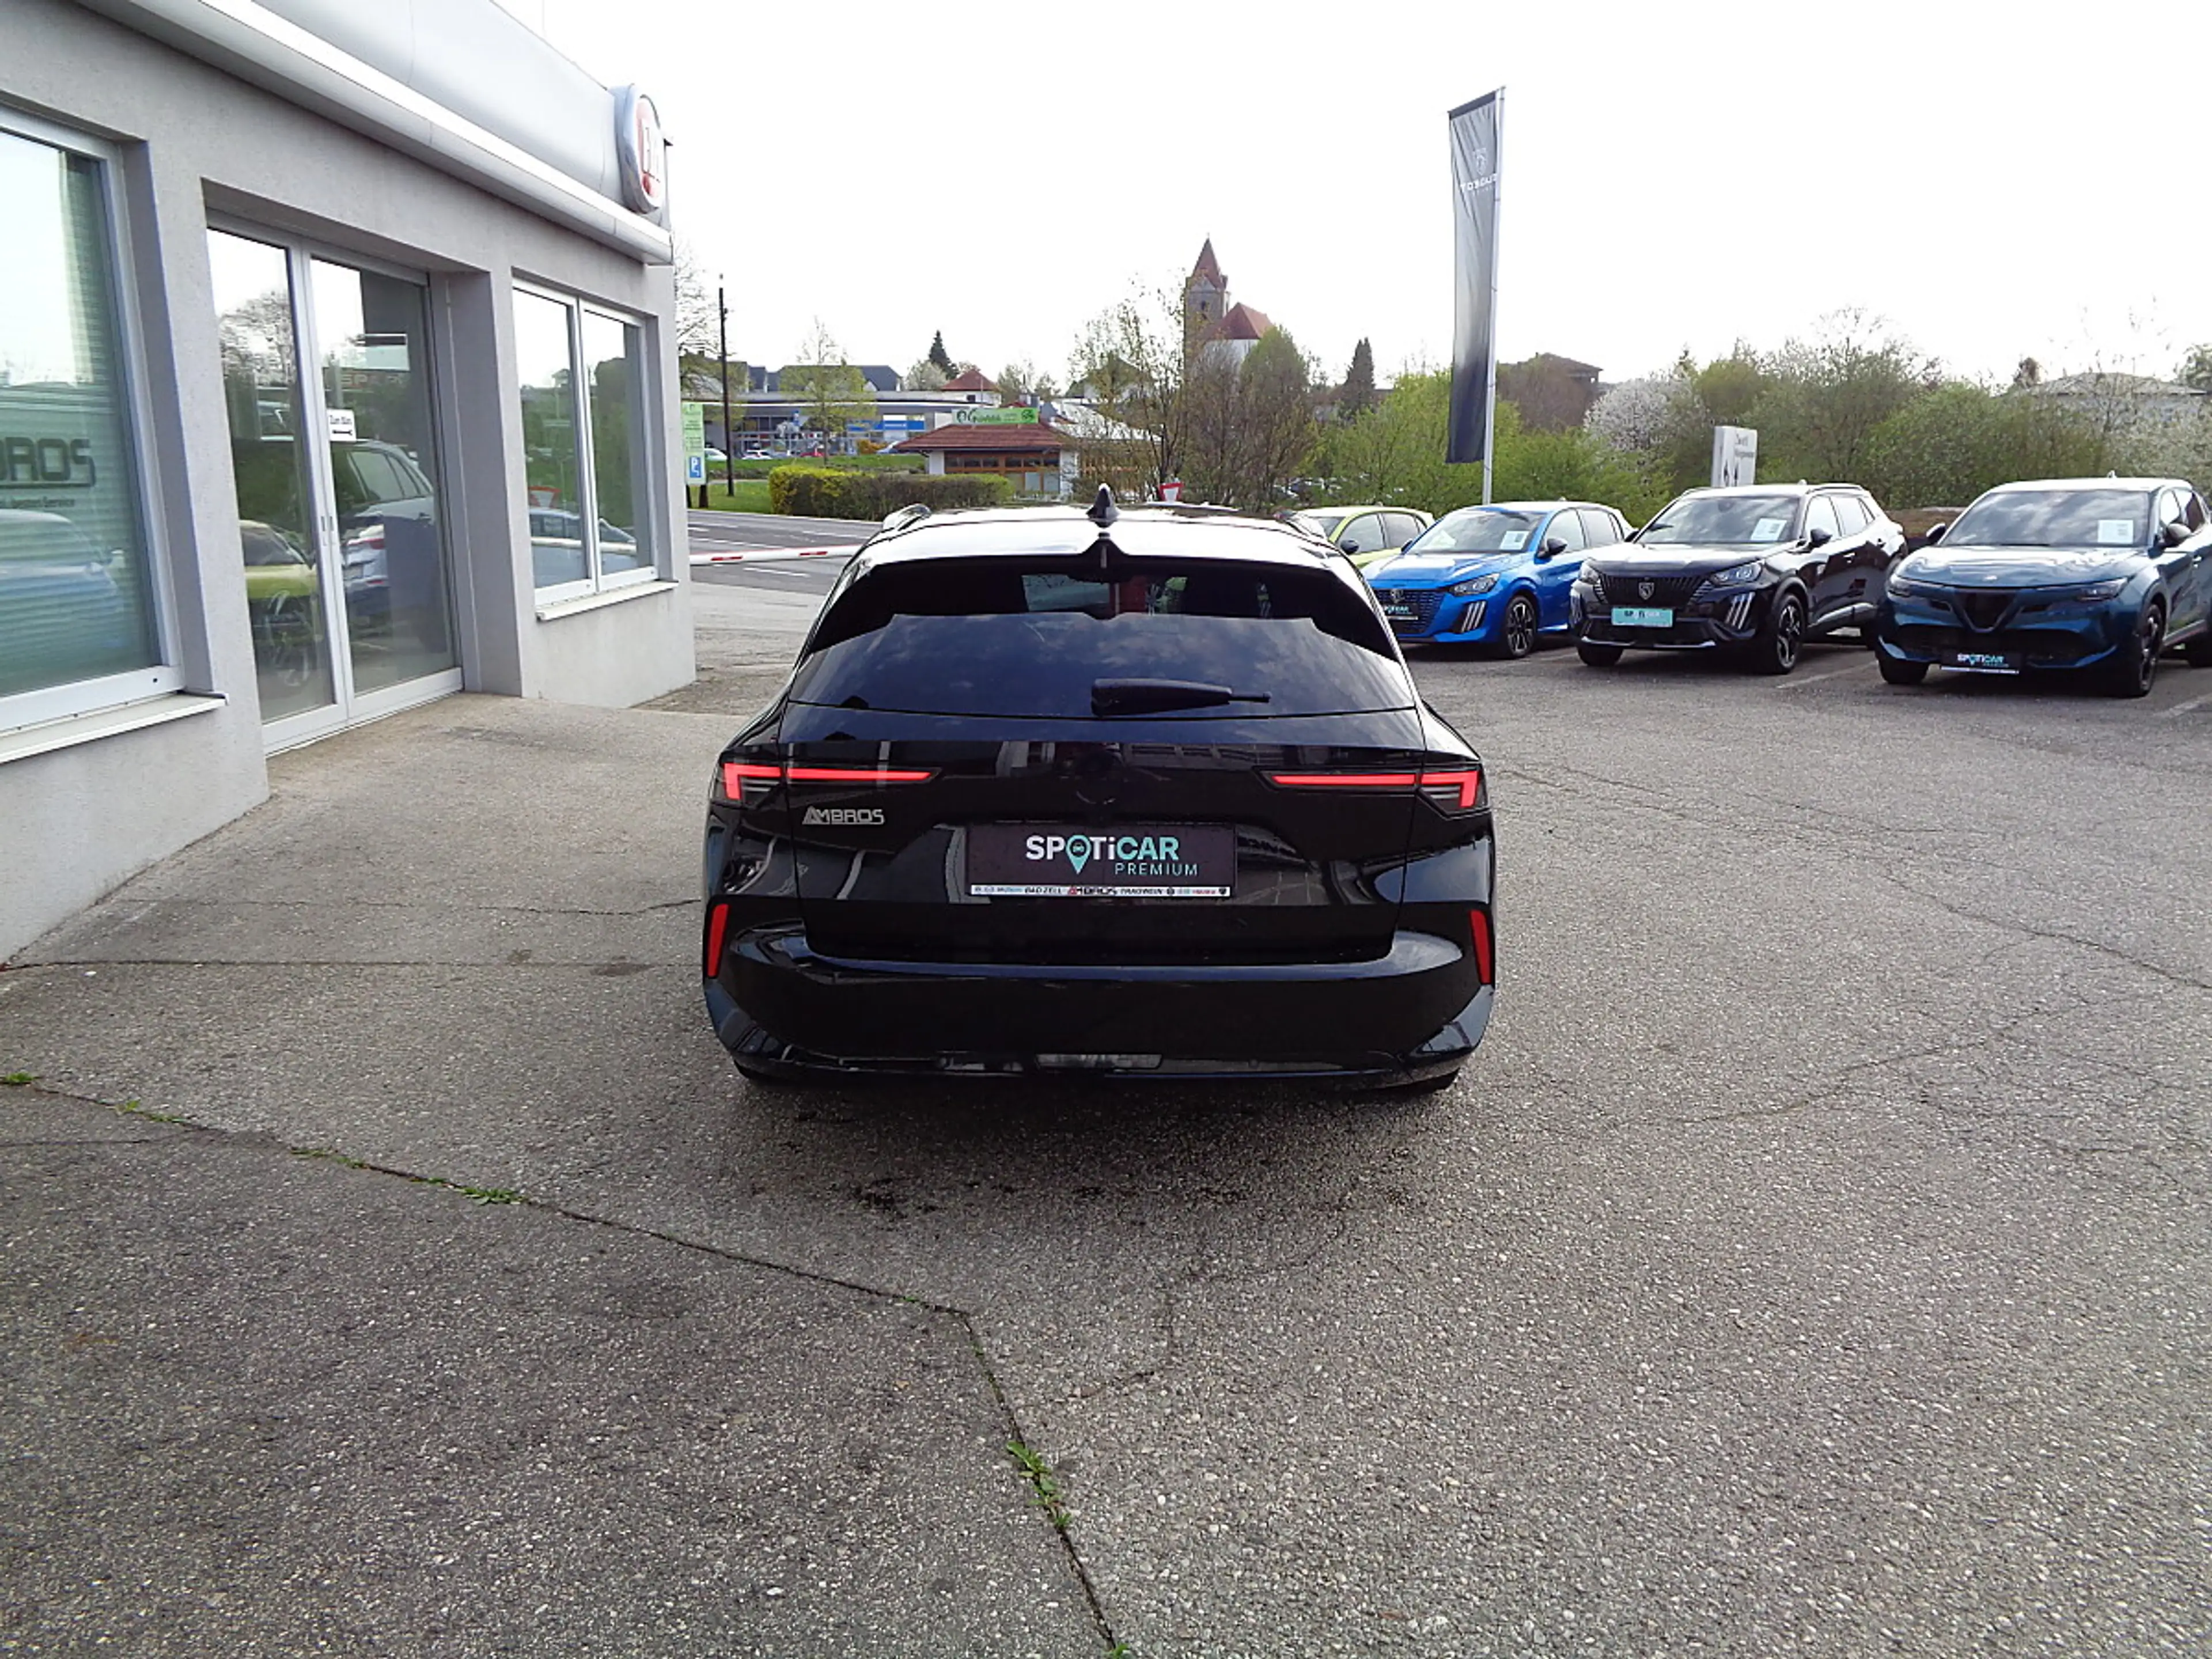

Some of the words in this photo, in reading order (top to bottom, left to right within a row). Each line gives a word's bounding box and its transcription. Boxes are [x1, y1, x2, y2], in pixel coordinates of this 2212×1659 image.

[0, 436, 96, 488] ROS
[802, 805, 885, 825] AMBROS
[1115, 863, 1198, 876] PREMIUM
